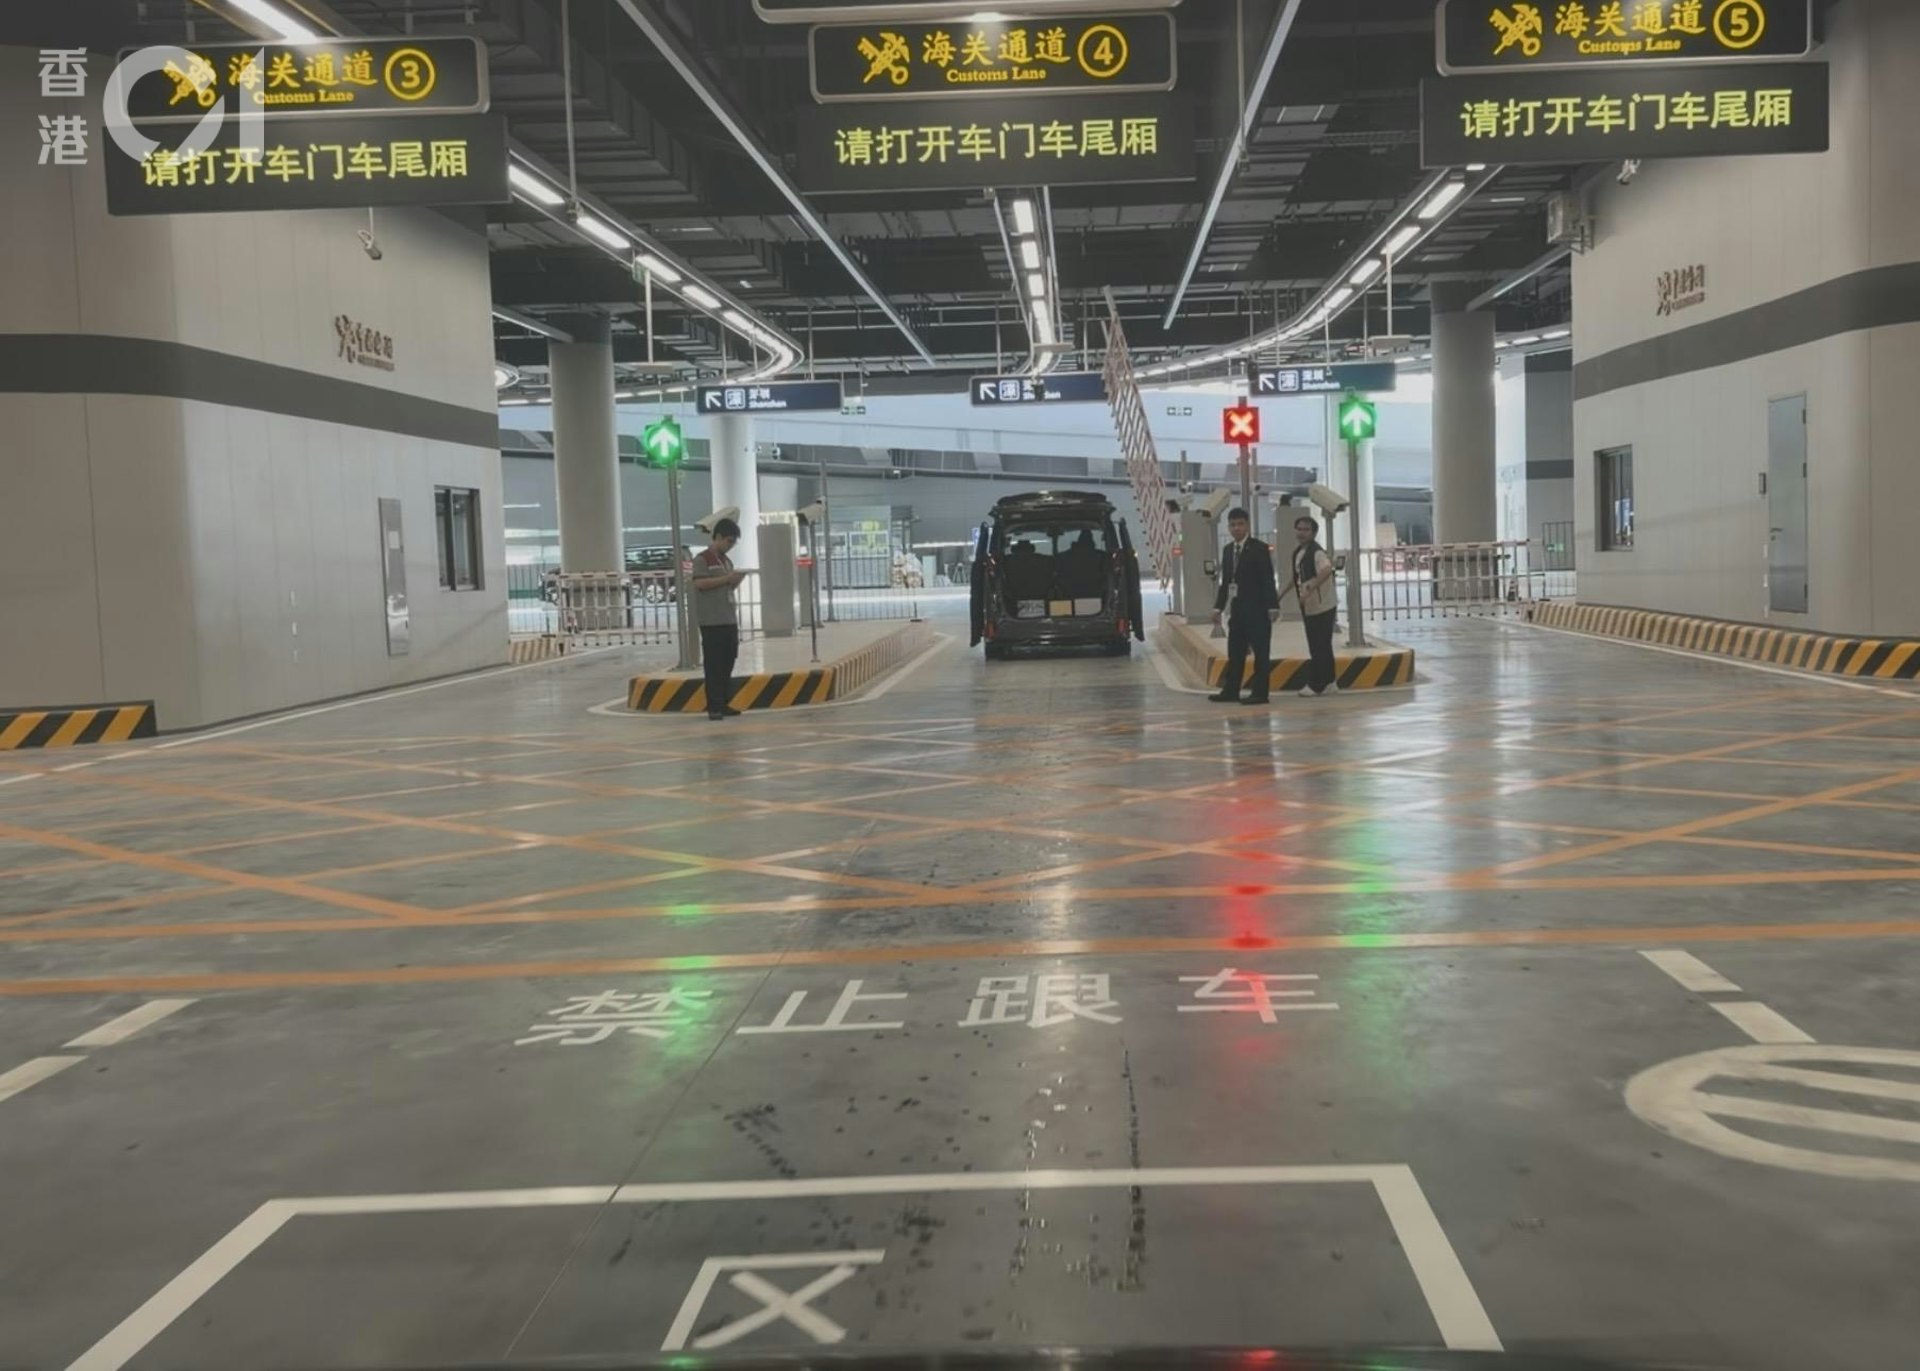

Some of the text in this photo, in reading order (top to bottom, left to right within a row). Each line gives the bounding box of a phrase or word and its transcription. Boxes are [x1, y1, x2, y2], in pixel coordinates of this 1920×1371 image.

[1555, 0, 1706, 38] 海关通道
[923, 27, 1071, 67] 海关通道
[1578, 38, 1681, 54] Customs Lane
[229, 51, 377, 90] 海关通道
[947, 67, 1046, 83] Customs Lane
[253, 88, 354, 105] Customs Lane
[1460, 89, 1792, 139] 请打开车门车尾厢
[834, 117, 1158, 166] 请打开车门车尾厢
[141, 140, 468, 187] 请打开车门车尾厢
[514, 967, 1339, 1045] 禁止跟车
[660, 1249, 886, 1351] 区
